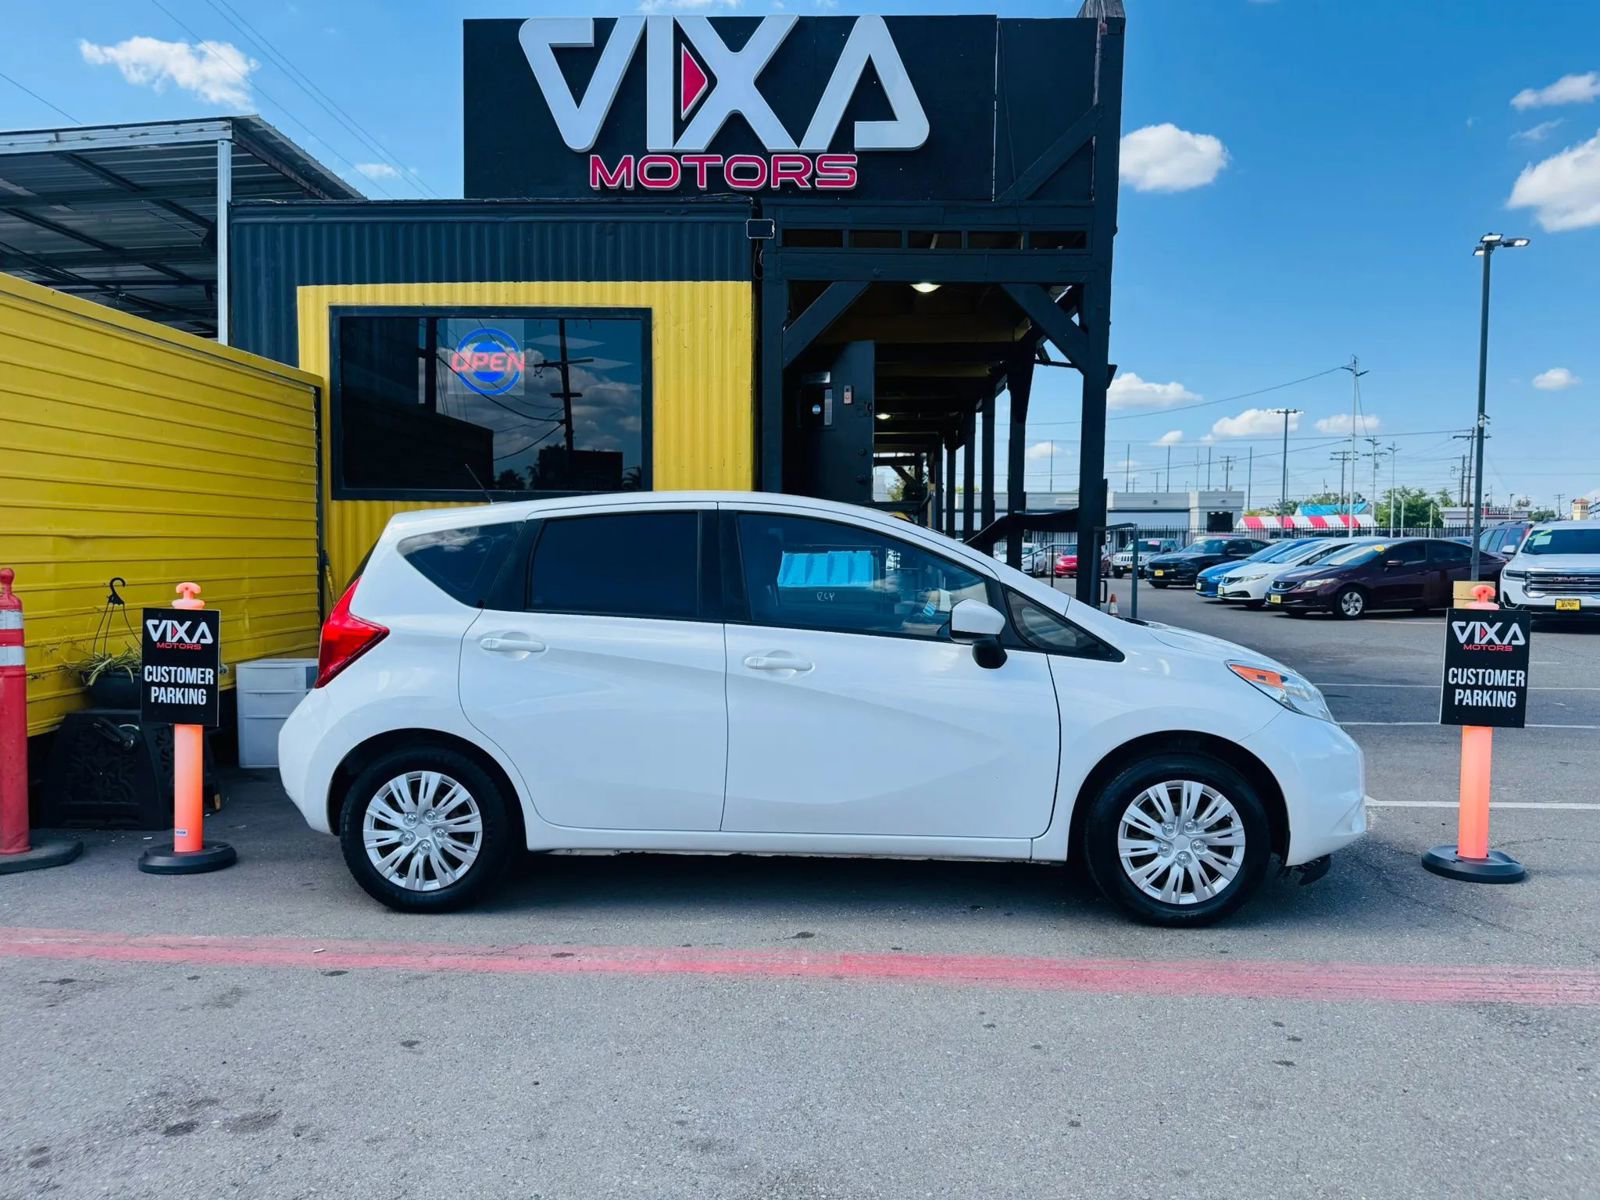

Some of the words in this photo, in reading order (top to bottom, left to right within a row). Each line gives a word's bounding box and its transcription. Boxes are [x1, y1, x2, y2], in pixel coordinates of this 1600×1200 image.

[518, 14, 931, 153] VIXA
[589, 154, 859, 191] MOTORS
[450, 352, 526, 374] OPEN
[145, 619, 214, 645] VIXA
[1451, 621, 1526, 646] VIXA
[156, 642, 202, 651] MOTORS
[1463, 644, 1513, 652] MOTORS
[144, 665, 215, 685] CUSTOMER
[1448, 667, 1526, 687] CUSTOMER
[151, 686, 207, 706] PARKING
[1454, 689, 1518, 708] PARKING
